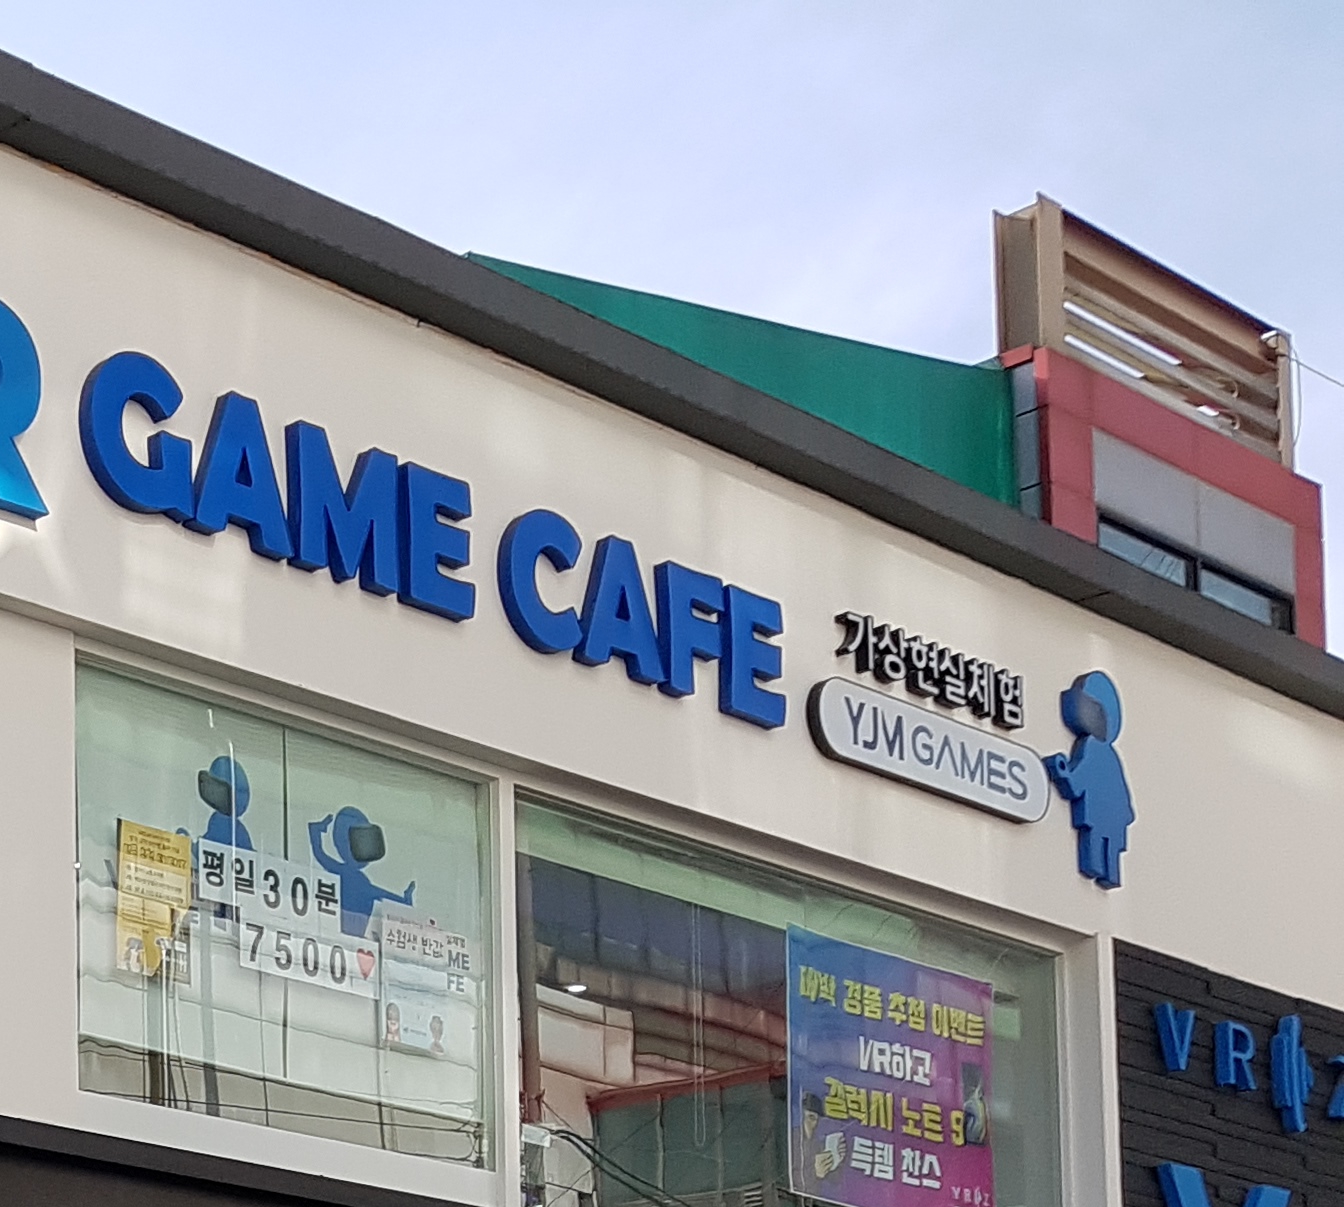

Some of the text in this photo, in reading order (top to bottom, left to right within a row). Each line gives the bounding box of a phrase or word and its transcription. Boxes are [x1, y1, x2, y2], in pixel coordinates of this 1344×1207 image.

[78, 350, 477, 624] GAME
[496, 507, 788, 732] CAFE
[834, 611, 1025, 730] 가상현실체험
[844, 695, 1028, 801] YJM GAMES
[202, 850, 256, 896] 평일
[246, 922, 346, 984] 7500
[799, 965, 986, 1046] 대박 경품 추첨 이벤트
[858, 1035, 932, 1087] VR하고
[824, 1077, 893, 1133] 갤럭시
[901, 1097, 944, 1143] 노트
[850, 1136, 942, 1190] 득템 찬스
